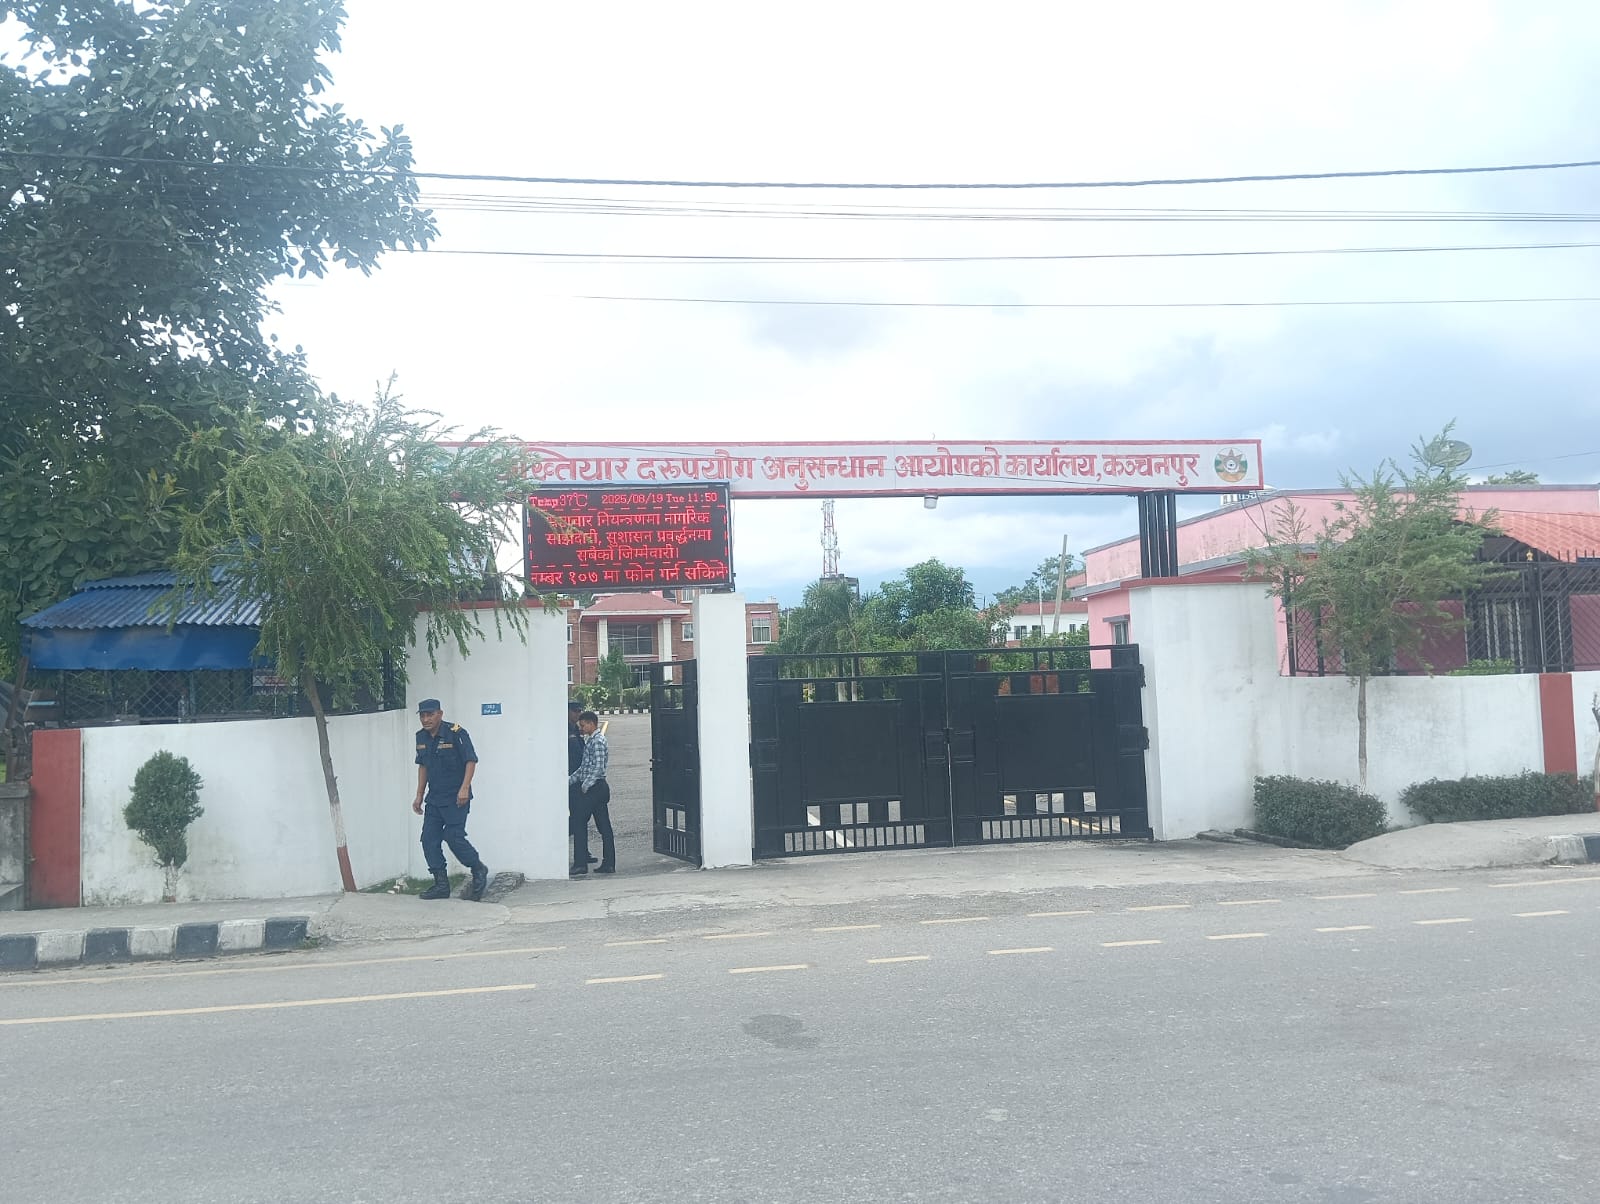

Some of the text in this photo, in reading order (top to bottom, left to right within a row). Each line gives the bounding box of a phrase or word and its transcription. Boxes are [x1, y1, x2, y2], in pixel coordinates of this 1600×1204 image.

[761, 456, 887, 491] अनुसन्धान
[895, 446, 1001, 478] आयोगको
[601, 493, 664, 505] 2025/08/19
[665, 493, 685, 503] Tue
[688, 491, 718, 503] 11:50
[664, 508, 710, 525] नागरिक
[606, 531, 654, 547] सुशासन
[530, 559, 728, 585] नम्बर १०७ मा फोन गर्न सकिने
